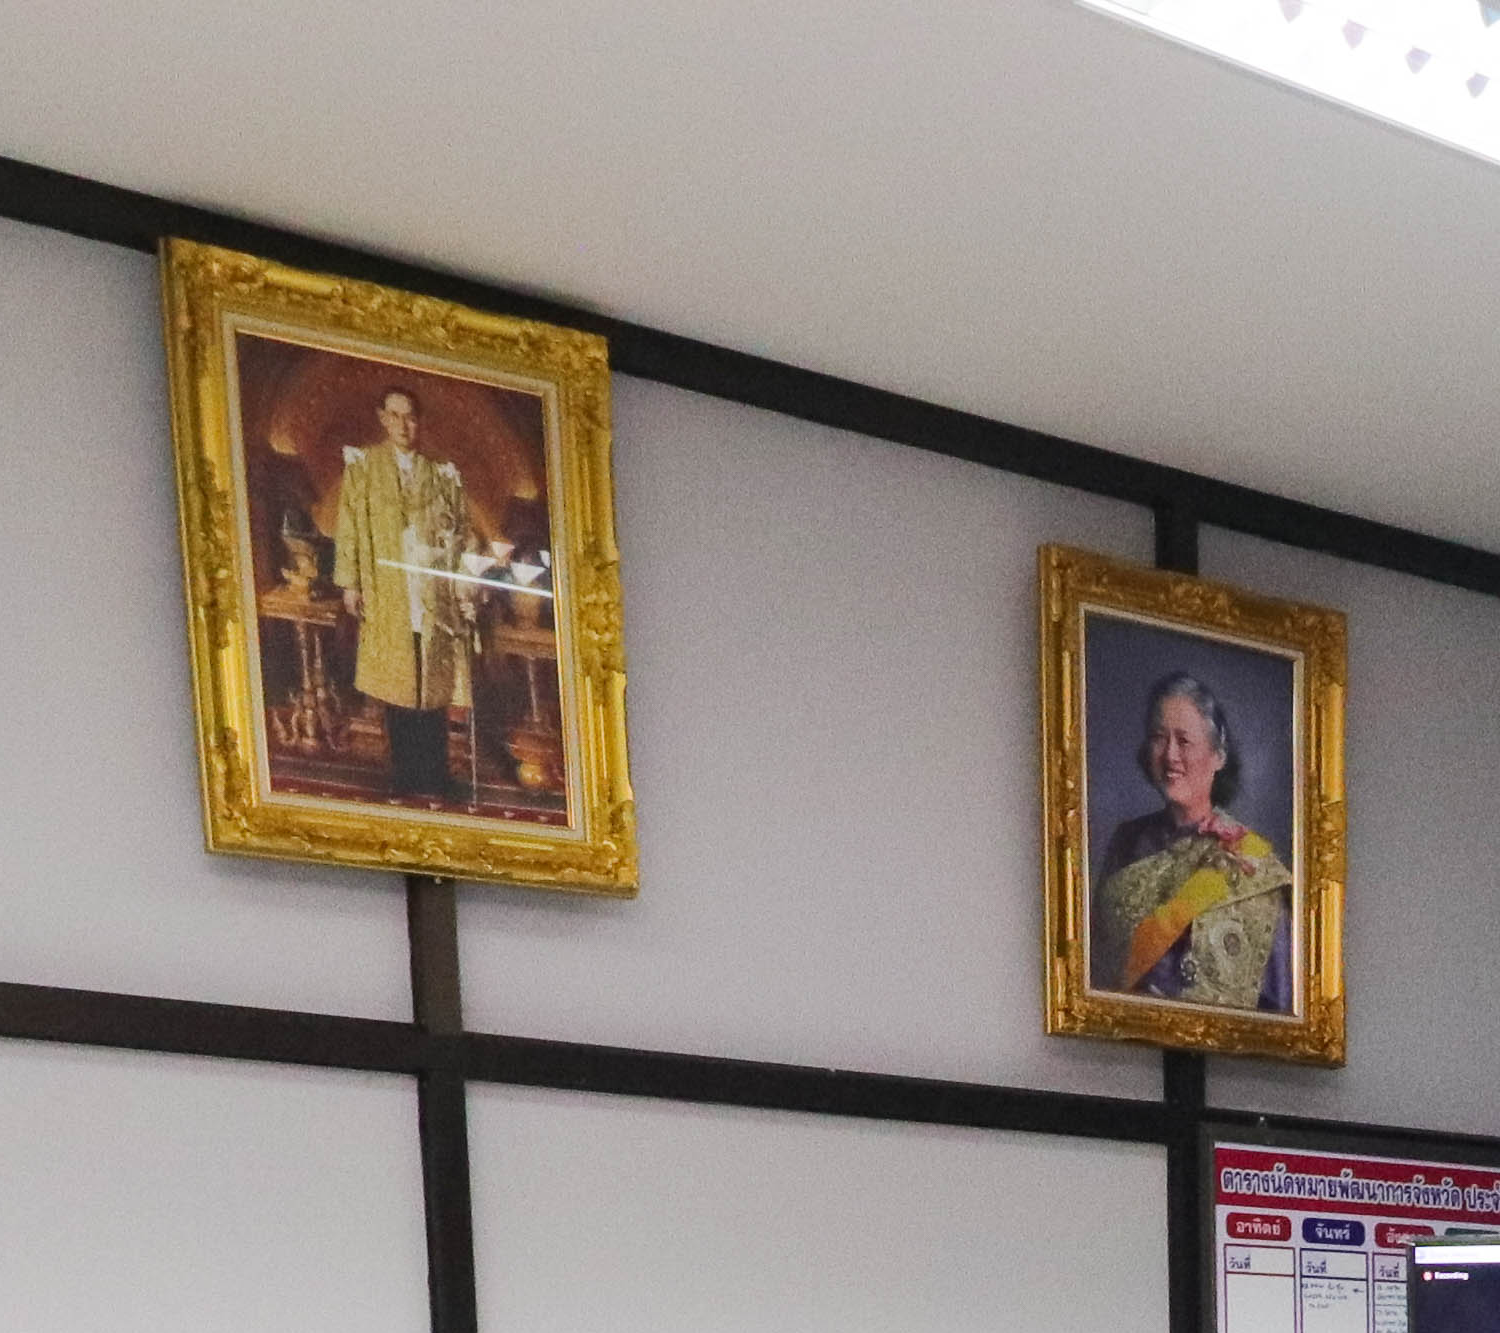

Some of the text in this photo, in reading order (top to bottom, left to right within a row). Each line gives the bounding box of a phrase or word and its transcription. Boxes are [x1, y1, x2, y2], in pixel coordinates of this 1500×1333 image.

[1221, 1163, 1462, 1210] ตารางนัดหมายพัฒนาการจังหวัด
[1236, 1218, 1281, 1235] อาทิตย์
[1315, 1223, 1351, 1241] จันทร์
[1229, 1256, 1251, 1270] วันที่
[1306, 1260, 1328, 1275] วันที่
[1379, 1263, 1400, 1278] วันที่
